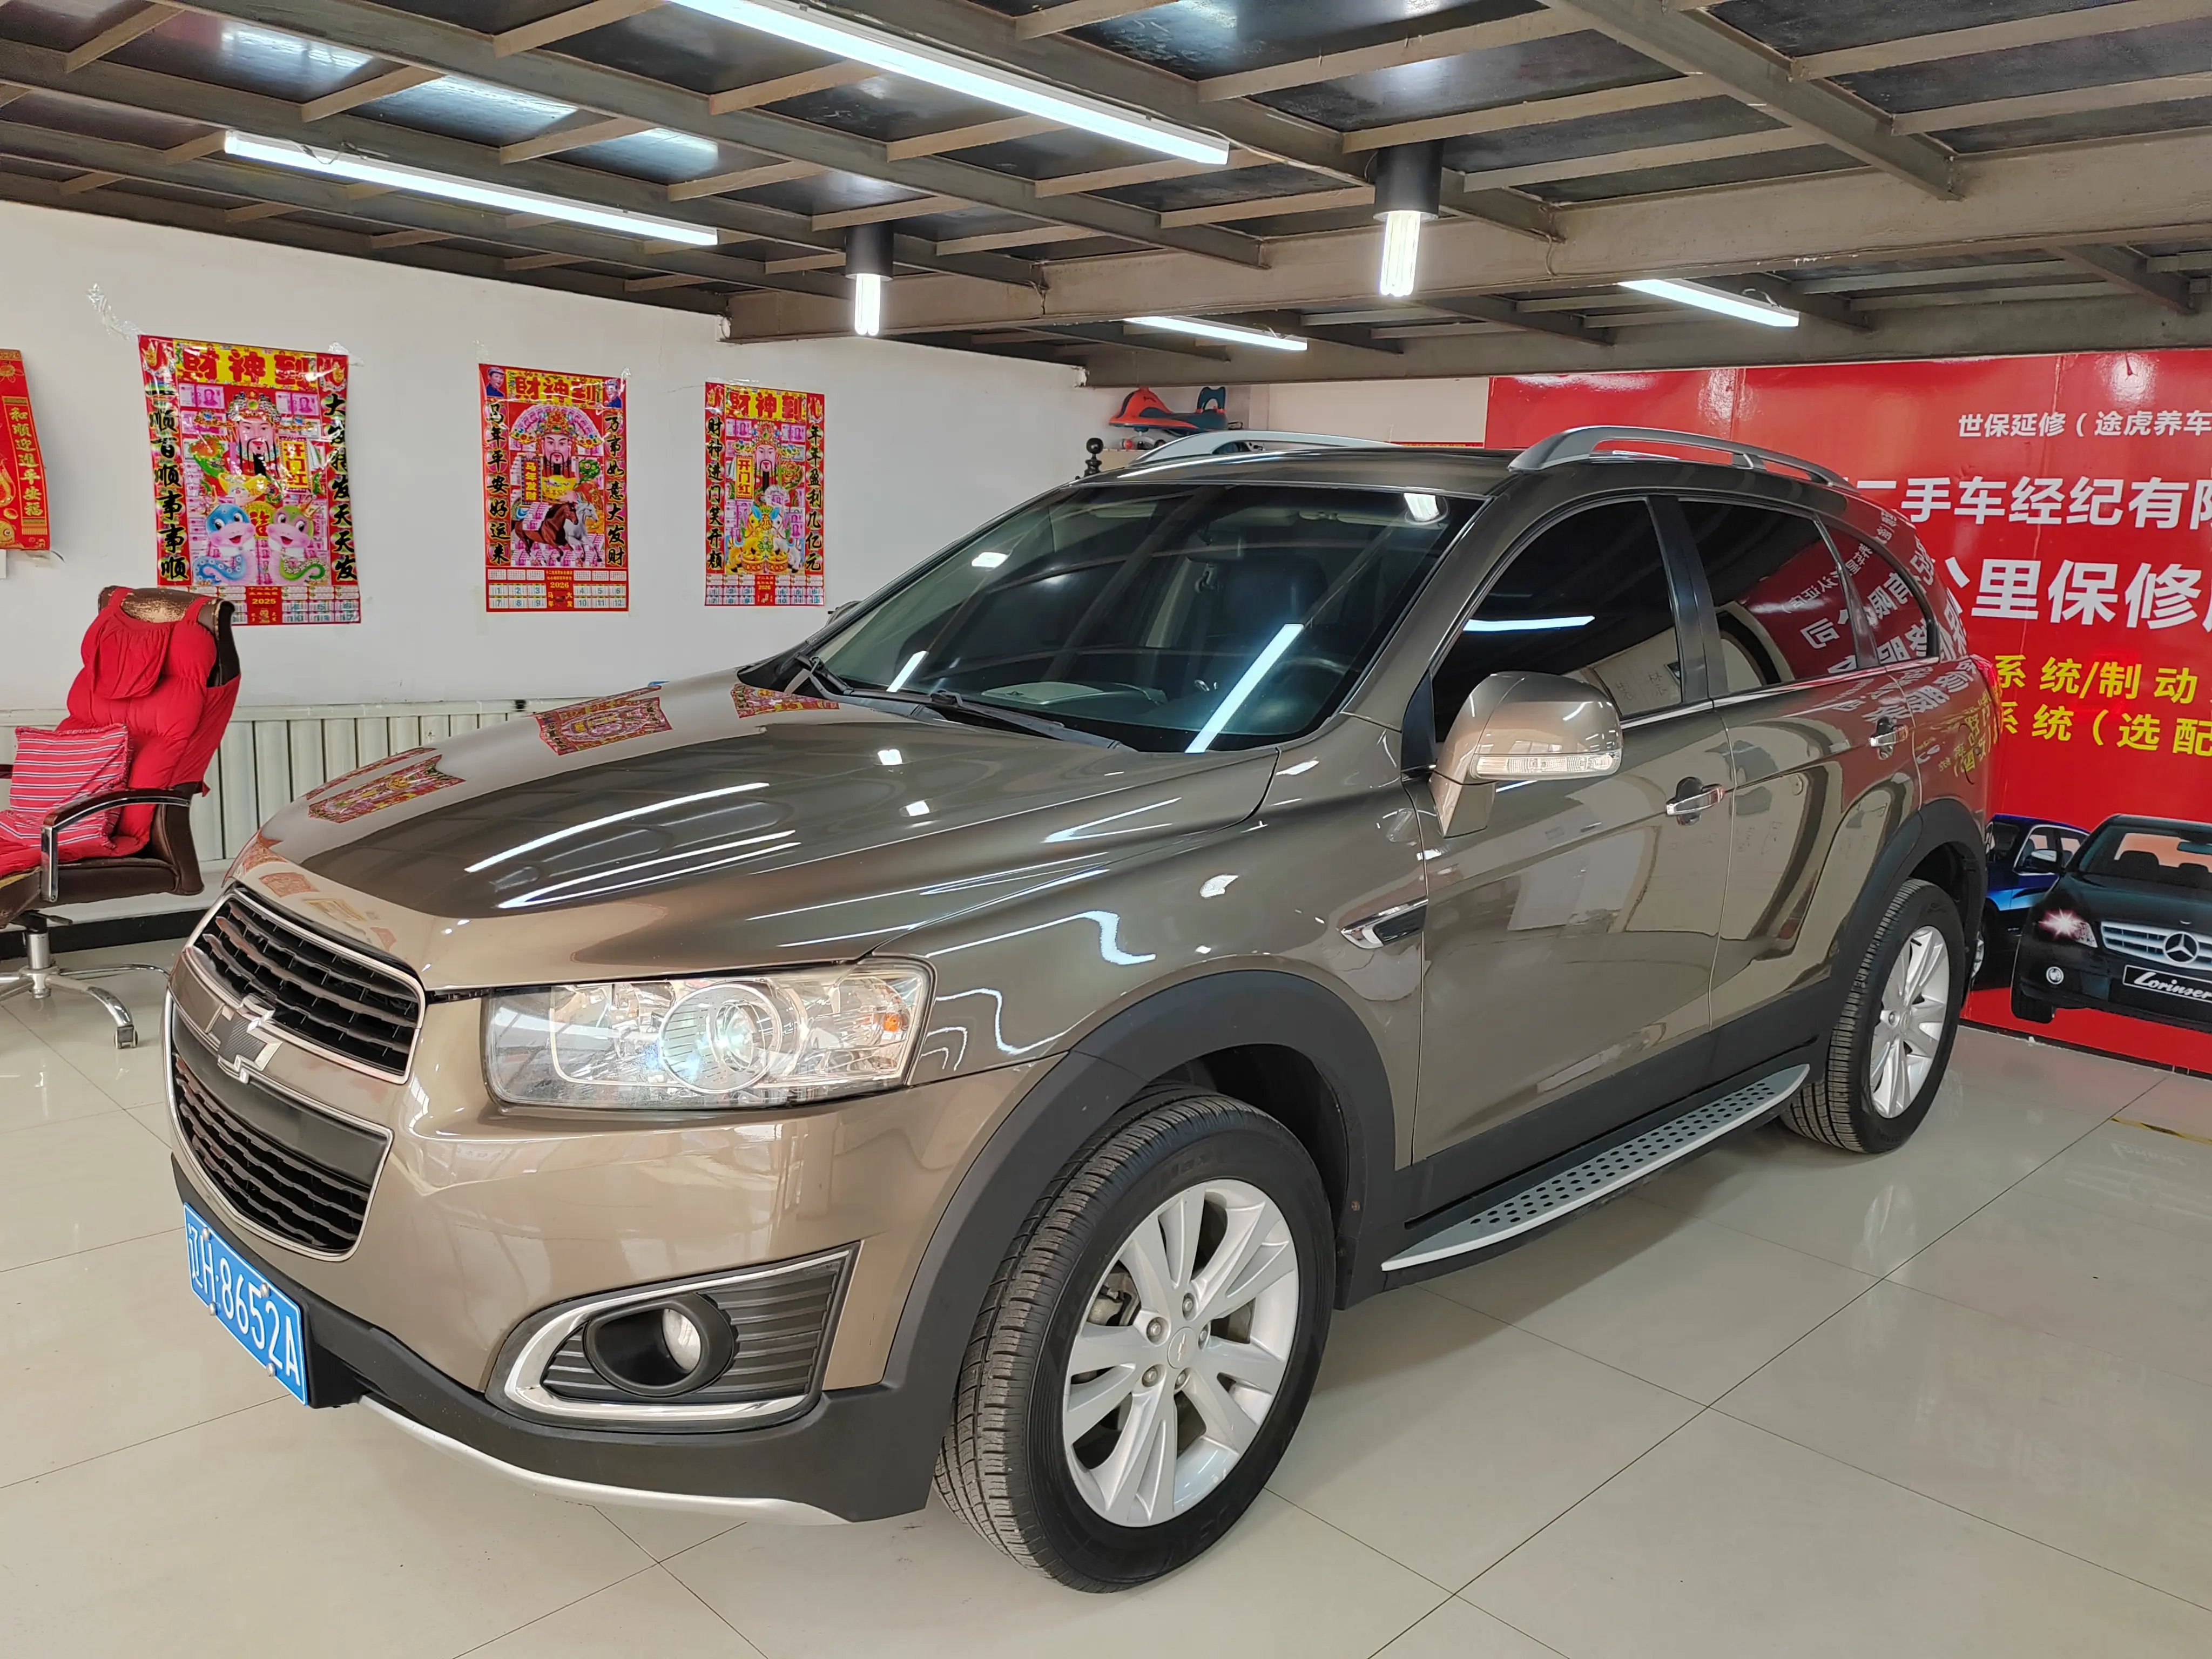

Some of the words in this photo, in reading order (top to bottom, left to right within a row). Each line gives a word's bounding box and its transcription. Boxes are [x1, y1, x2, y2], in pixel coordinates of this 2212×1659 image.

[604, 415, 625, 567] 万事如意大发财
[738, 460, 751, 494] 开门红
[1945, 556, 2212, 633] 里保修
[2134, 972, 2212, 999] Lorinser
